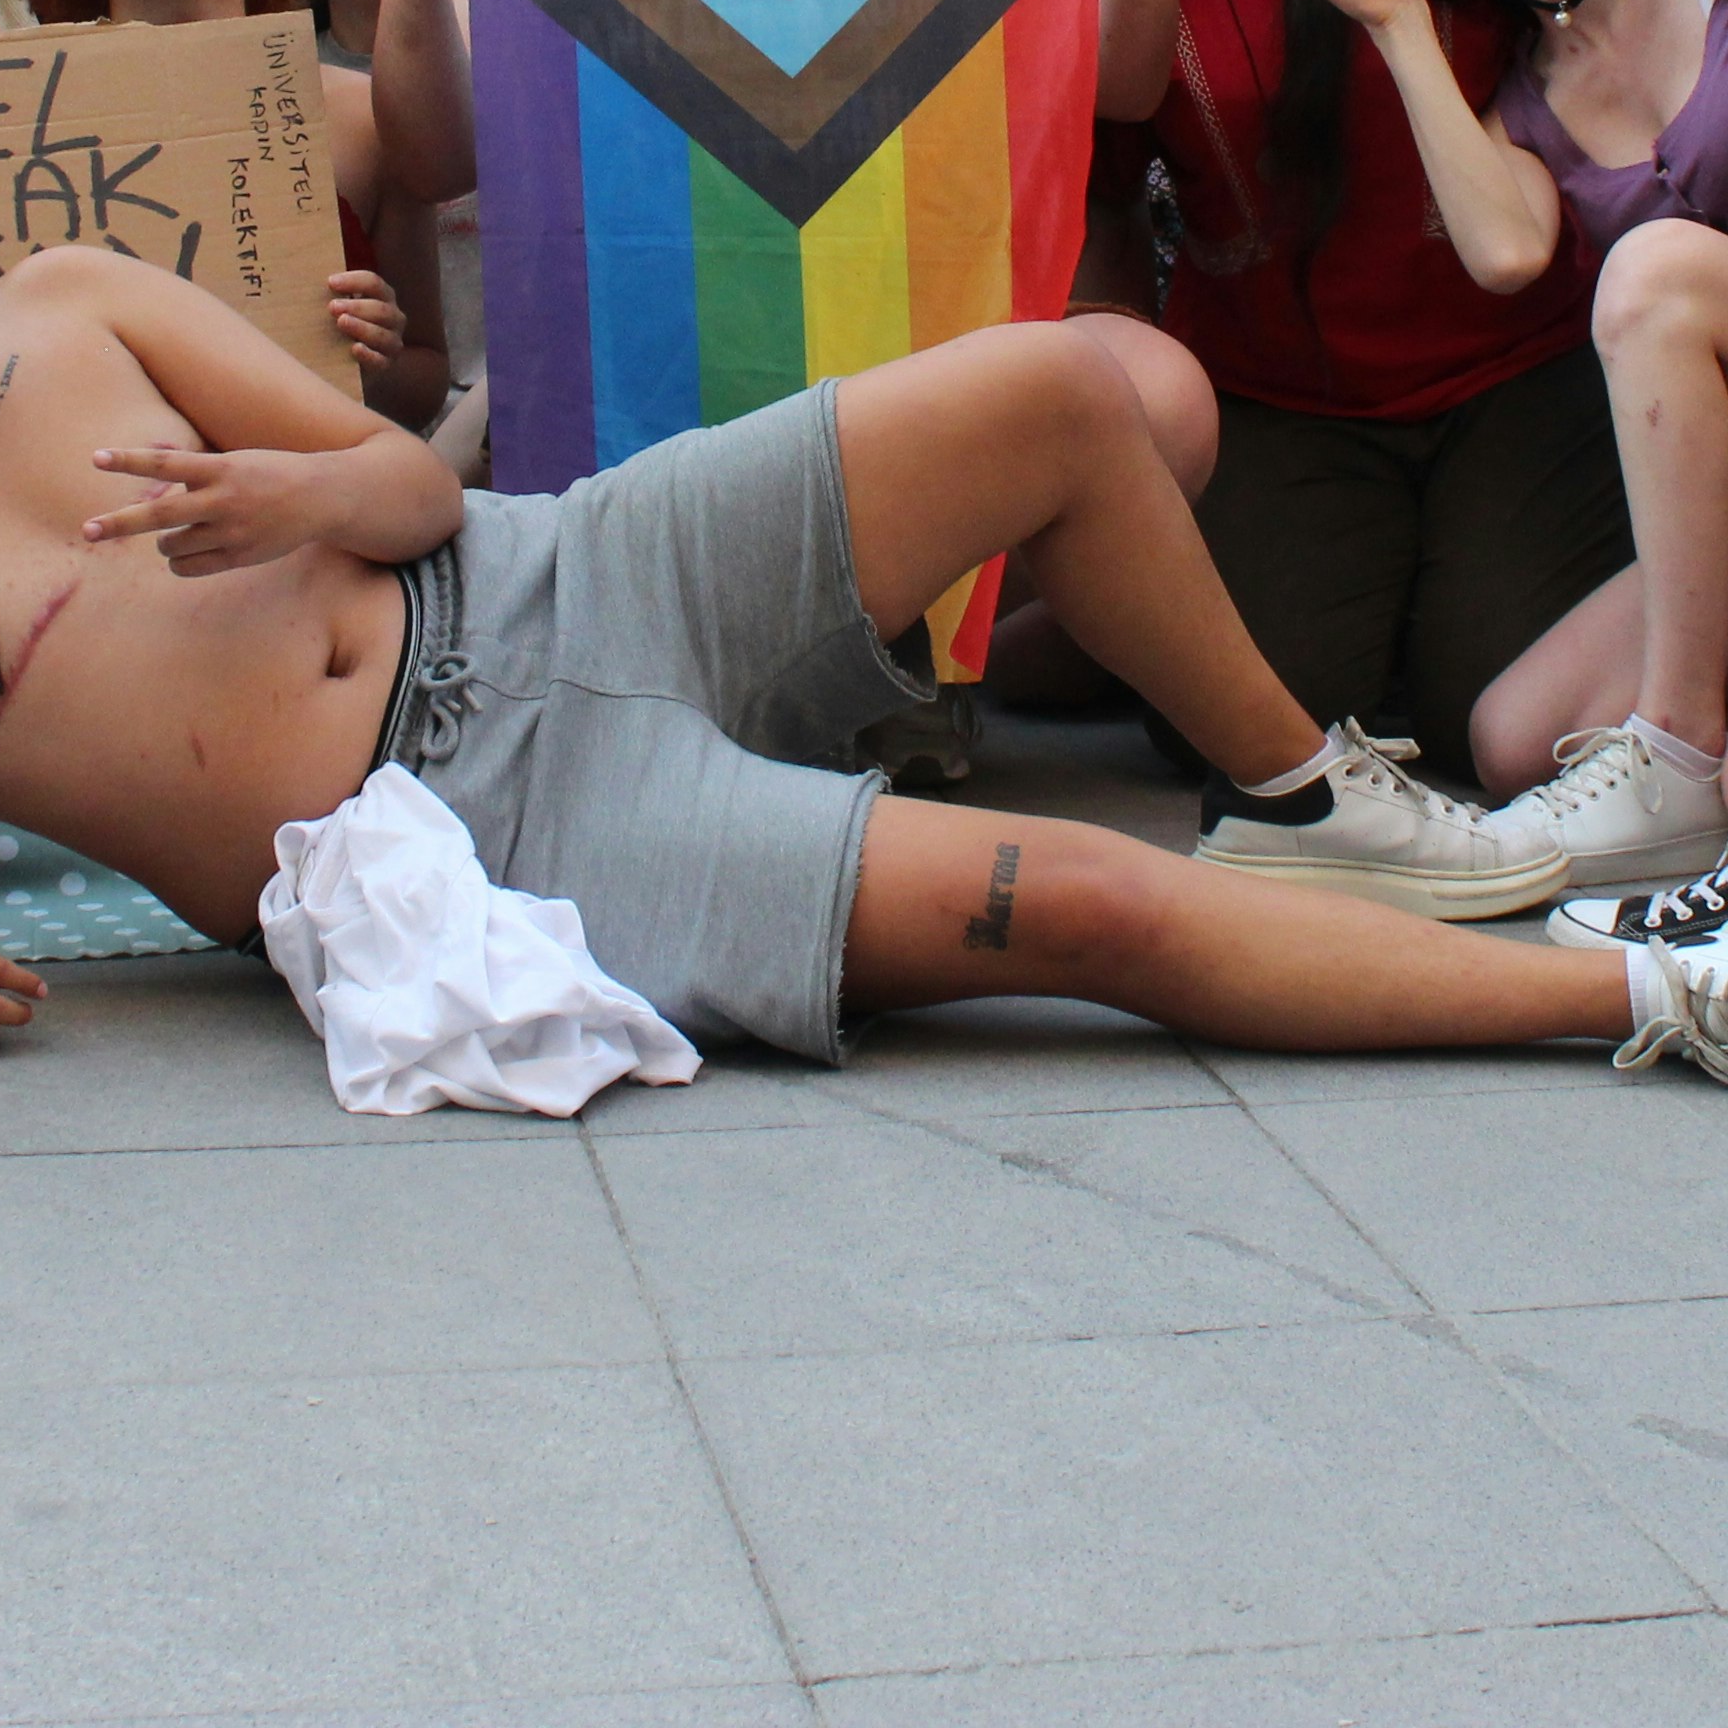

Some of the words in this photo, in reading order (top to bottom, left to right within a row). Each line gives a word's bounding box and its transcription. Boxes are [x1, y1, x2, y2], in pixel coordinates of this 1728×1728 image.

[243, 85, 276, 163] KADIN
[262, 30, 324, 217] ÜNİVERSİTELİ
[225, 157, 264, 300] KOLEKTİFİ
